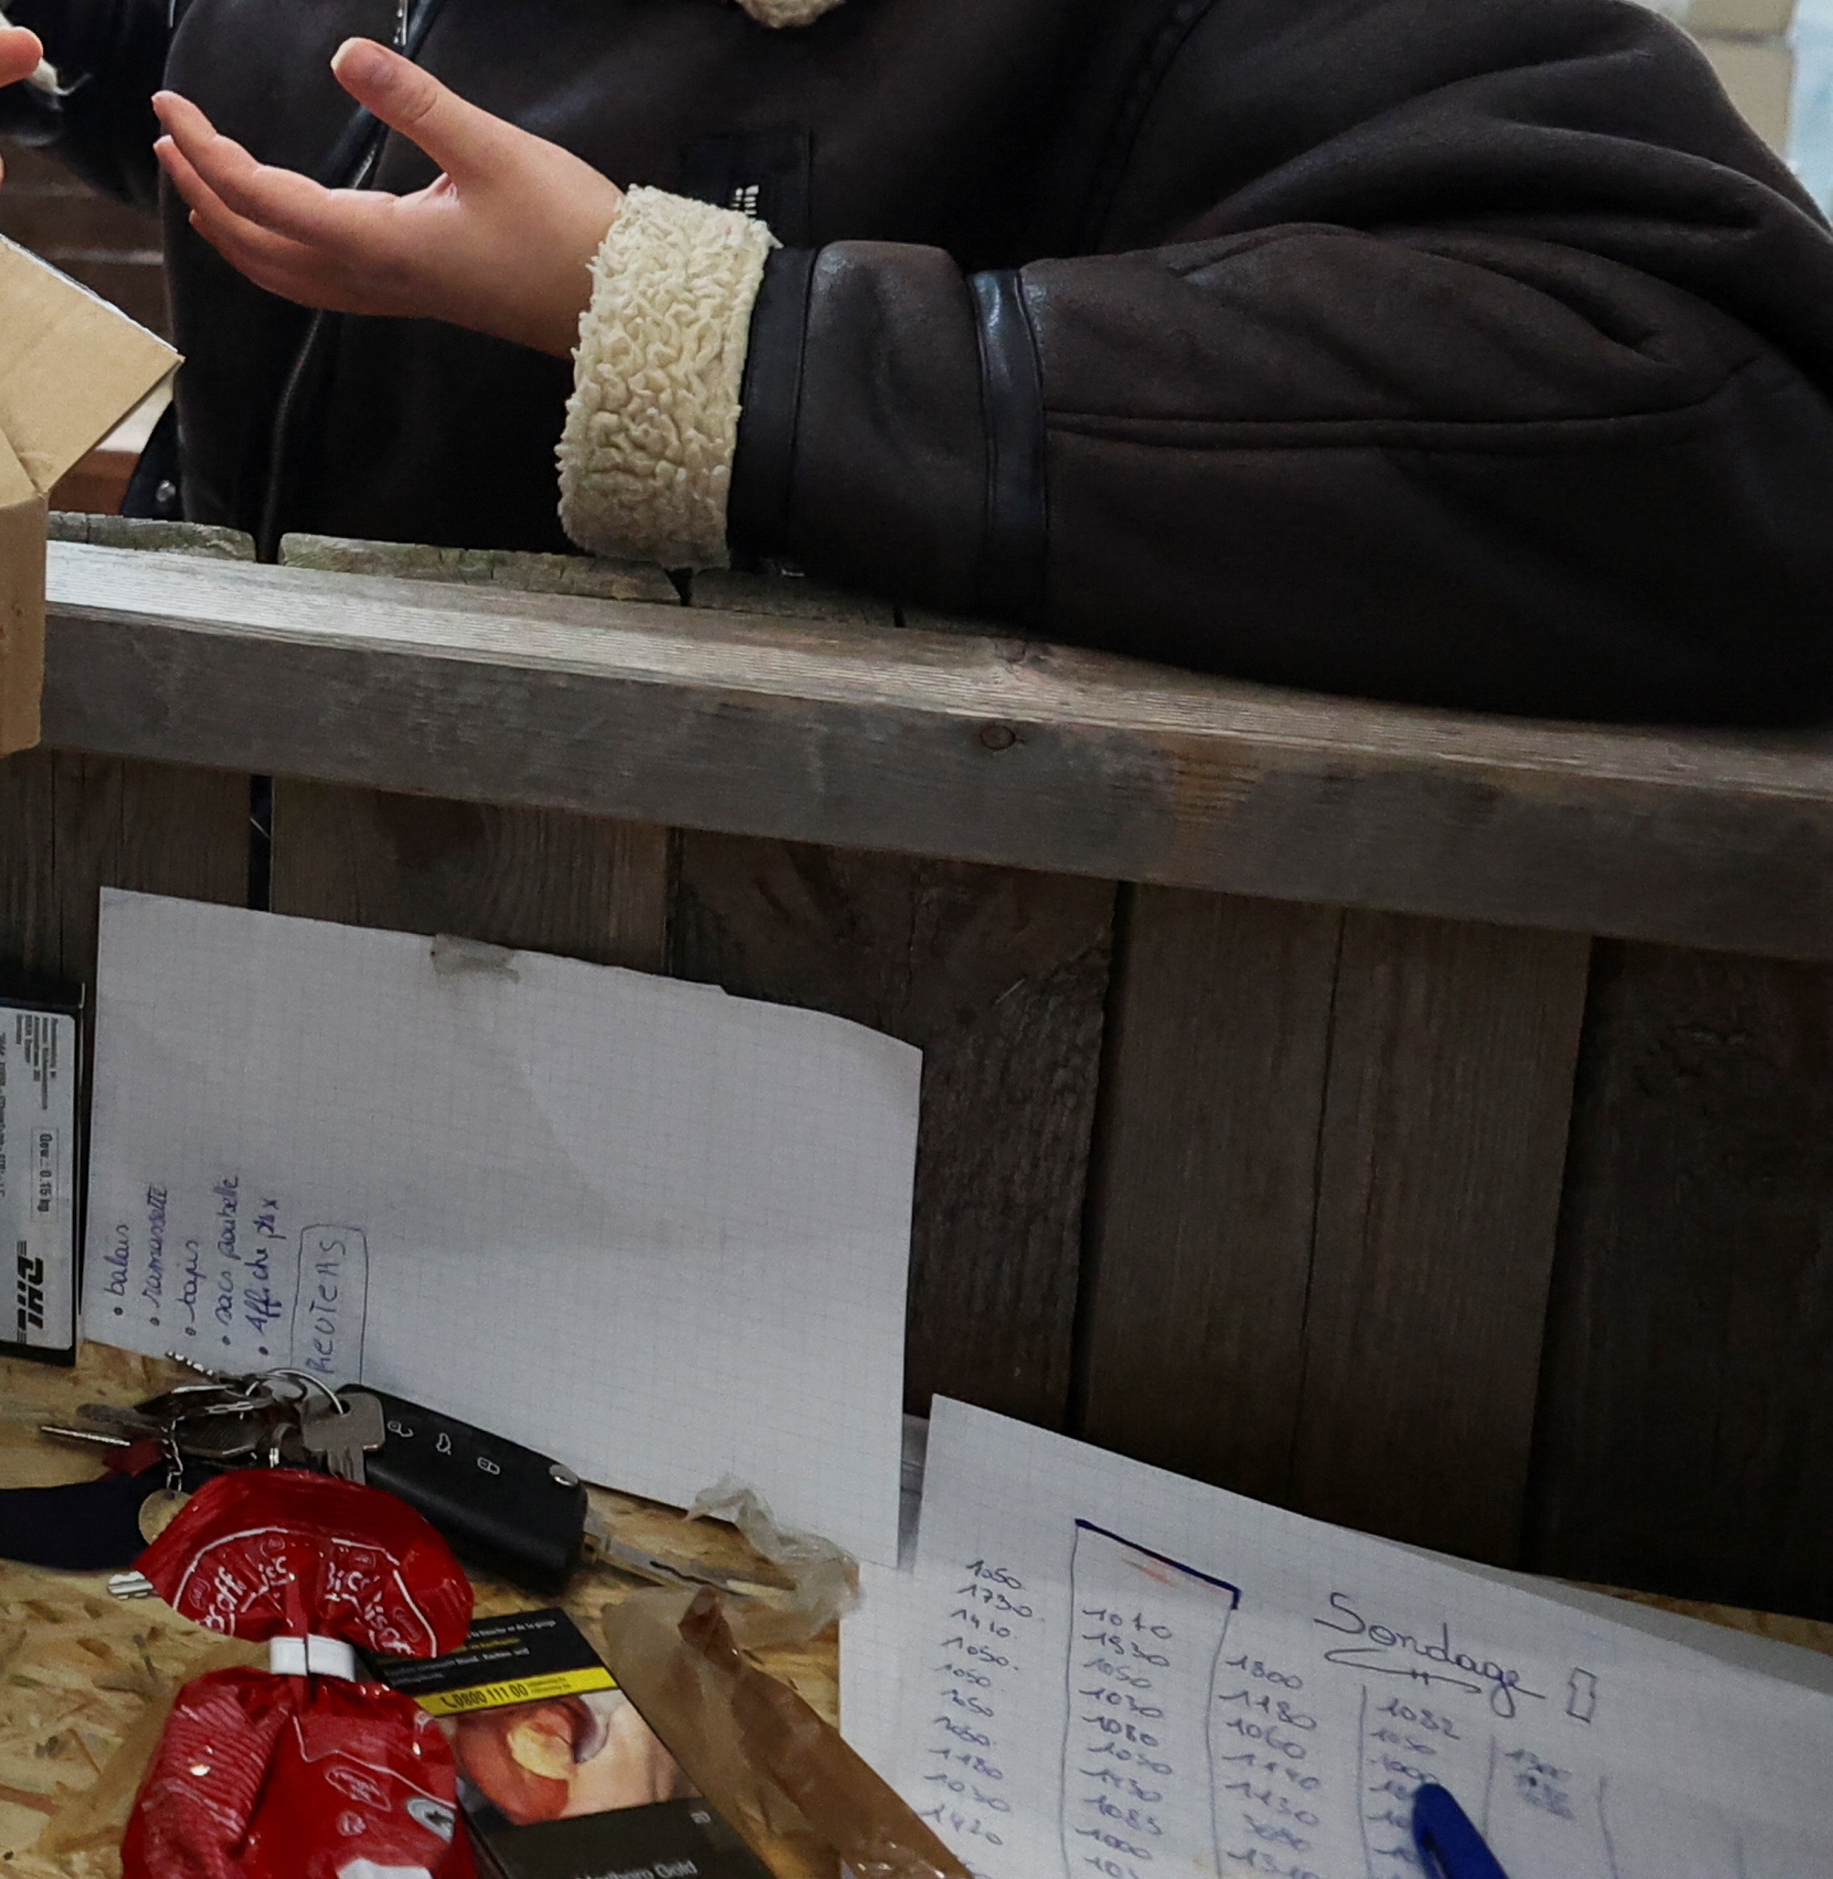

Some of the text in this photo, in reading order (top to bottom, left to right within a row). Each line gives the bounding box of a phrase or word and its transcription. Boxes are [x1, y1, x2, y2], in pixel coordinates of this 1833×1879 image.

[17, 1256, 44, 1331] DHL
[1314, 1591, 1546, 1719] Sondage
[453, 1691, 486, 1708] 0800
[487, 1686, 508, 1702] 111
[510, 1684, 529, 1697] 00
